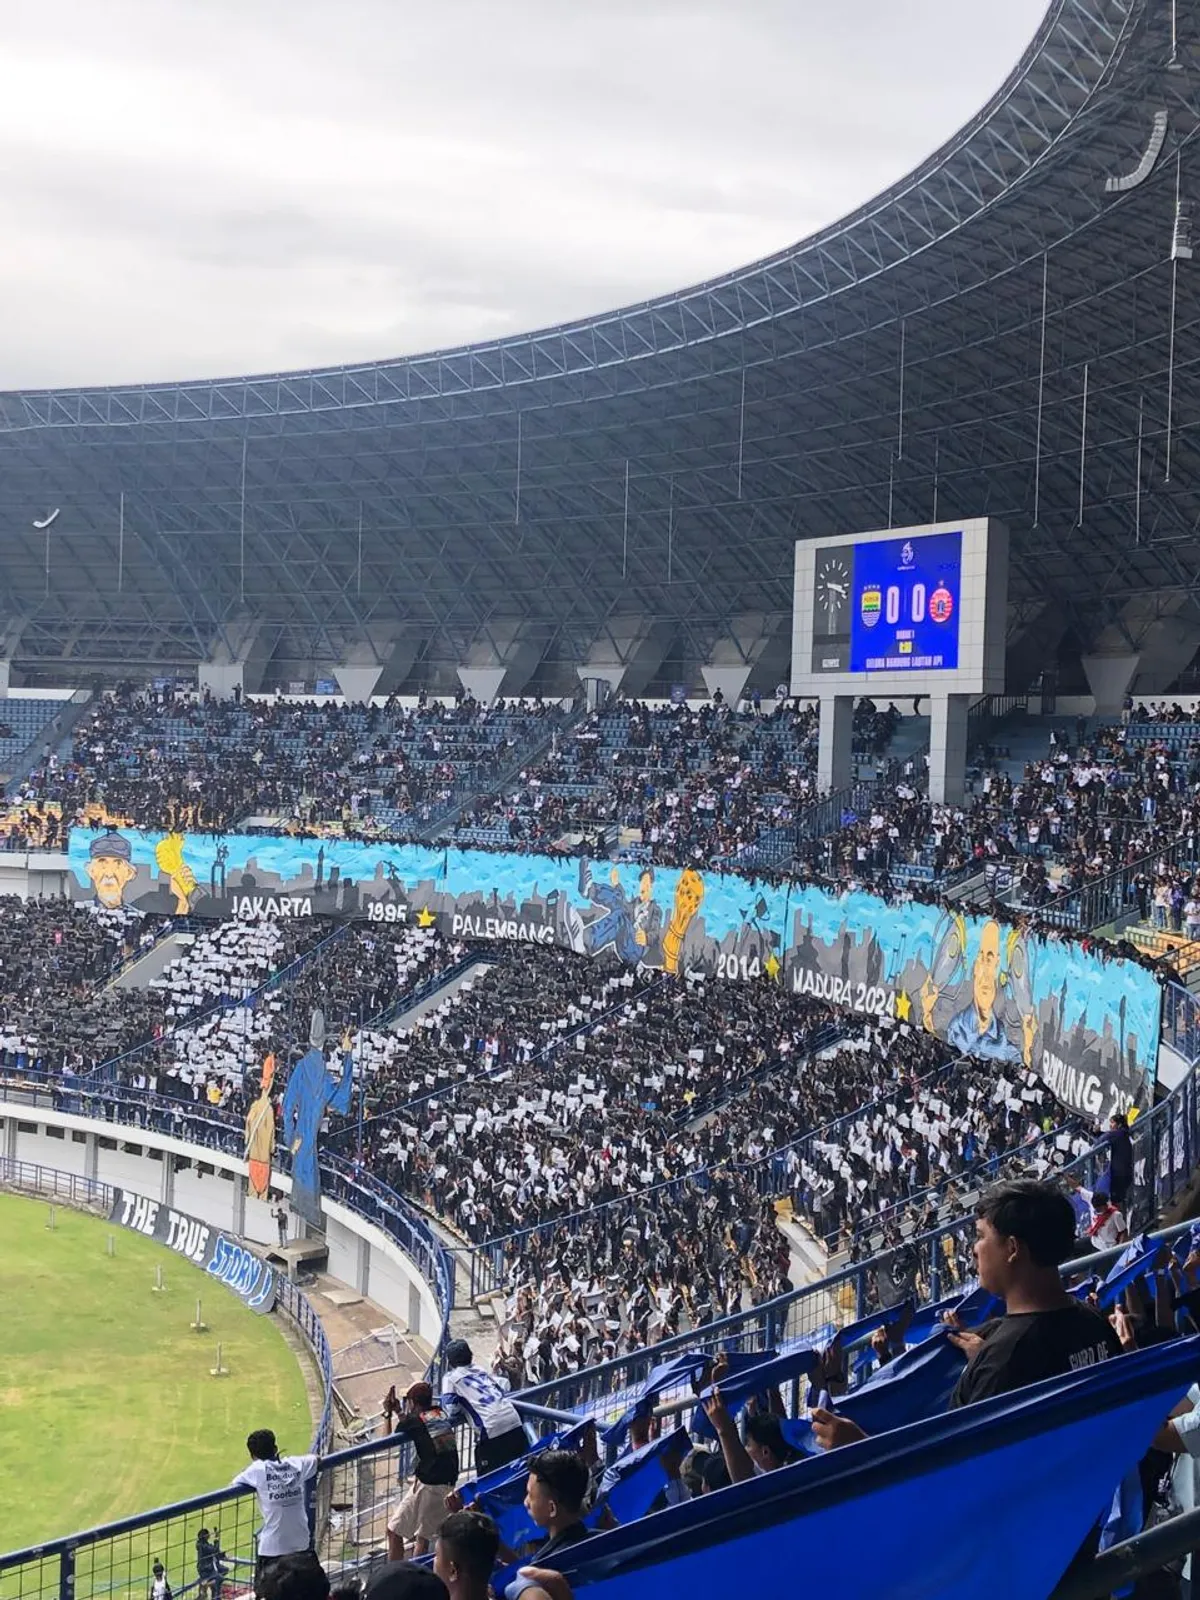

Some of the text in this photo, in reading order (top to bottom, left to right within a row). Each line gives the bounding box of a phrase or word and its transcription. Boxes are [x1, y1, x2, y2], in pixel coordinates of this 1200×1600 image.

[887, 583, 925, 624] 0 0
[231, 896, 407, 923] JAKARTA 1995
[452, 914, 760, 980] PALEMBANG 2014
[793, 967, 896, 1018] MADURA 2024
[121, 1190, 160, 1236] THE
[165, 1210, 210, 1263] TRUE
